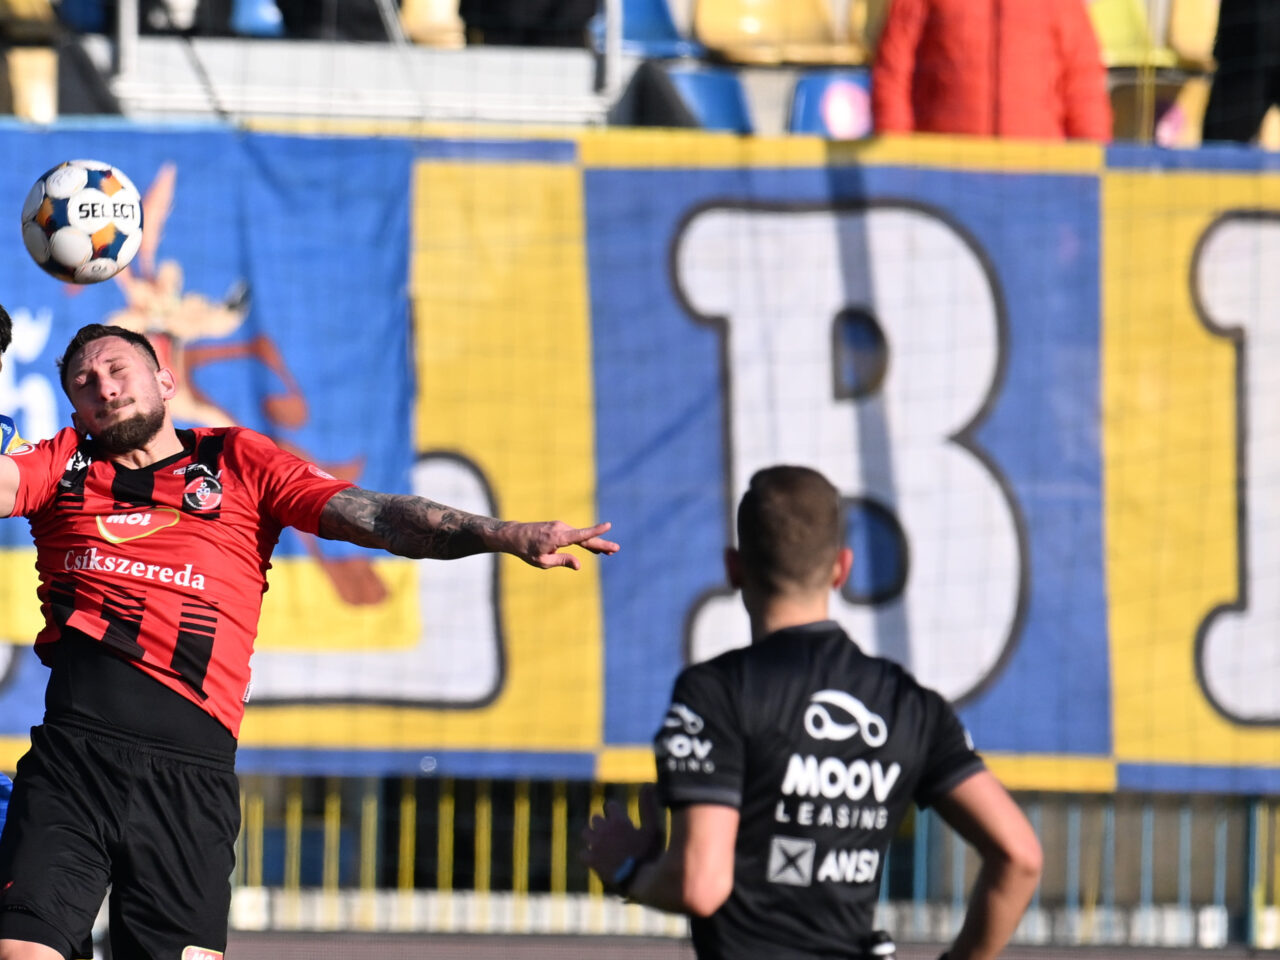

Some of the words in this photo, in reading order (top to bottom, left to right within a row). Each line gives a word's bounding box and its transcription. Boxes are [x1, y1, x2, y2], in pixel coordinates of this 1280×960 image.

[78, 202, 135, 219] SELECT
[106, 513, 152, 527] MOL
[64, 547, 206, 590] Csíkszereda
[781, 753, 901, 803] MOOV
[775, 800, 888, 830] LEASING
